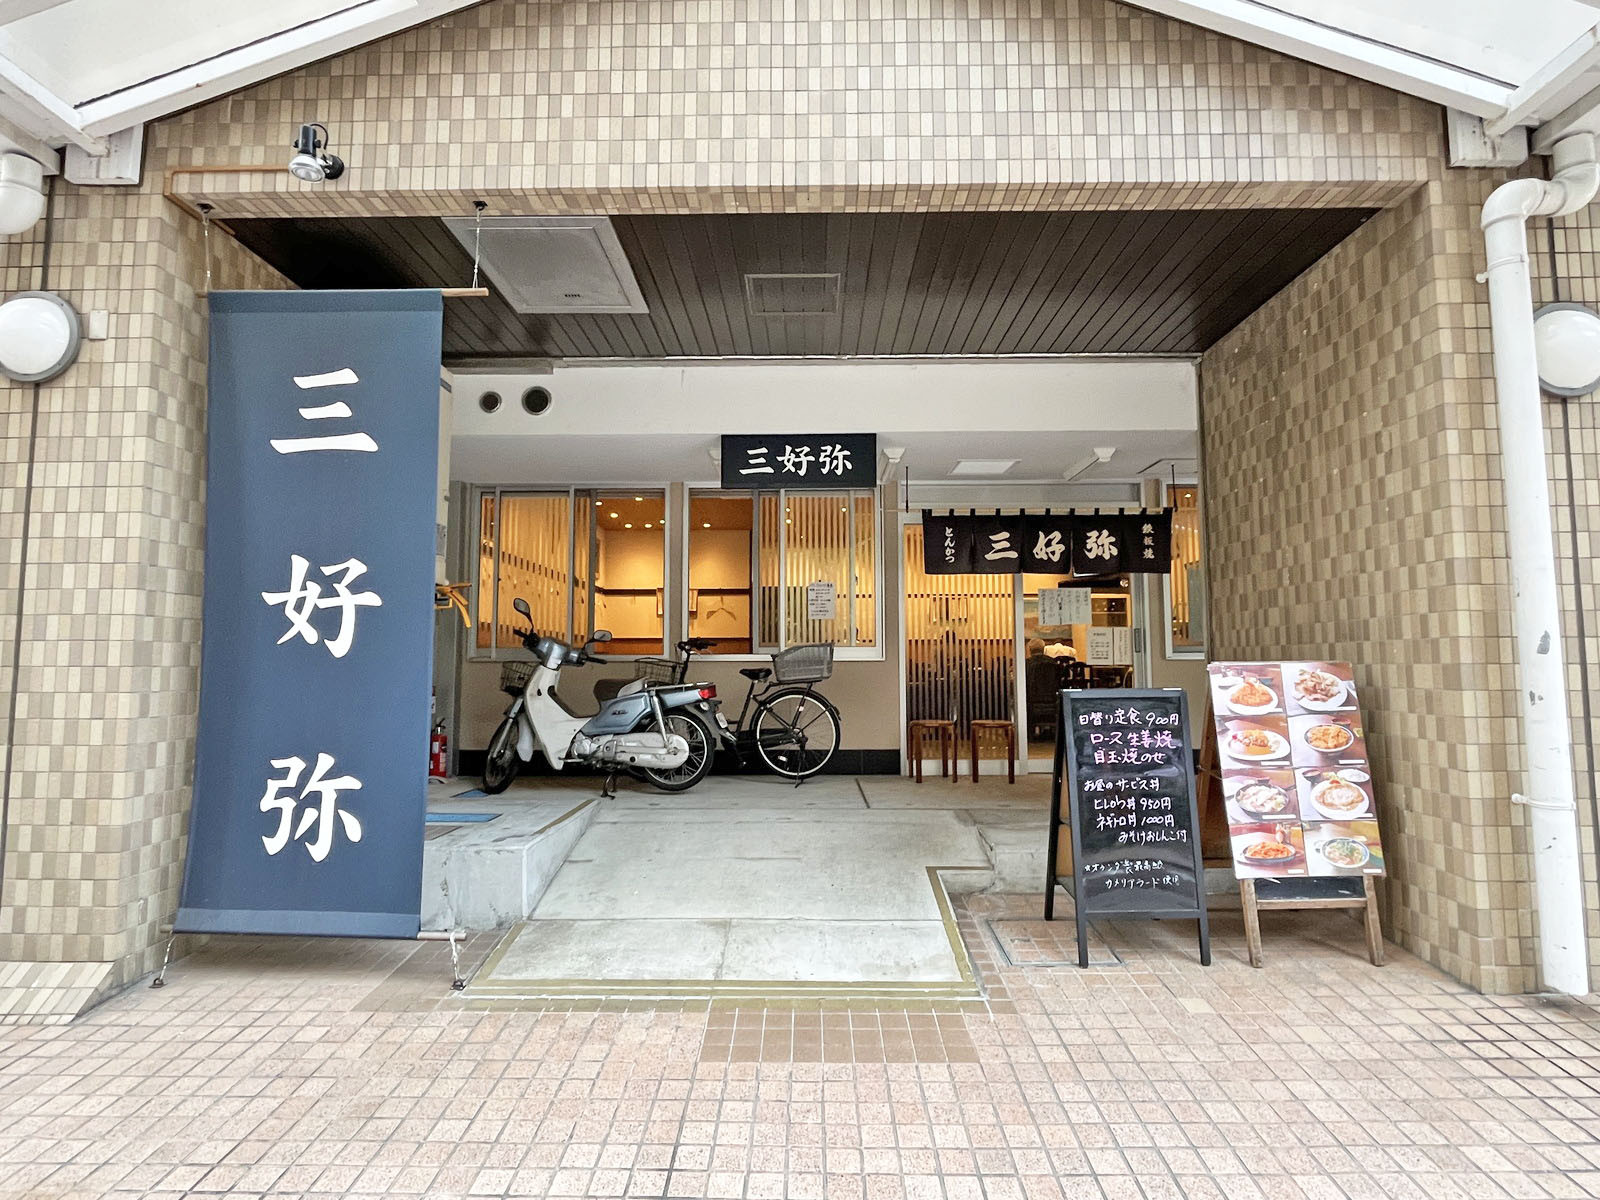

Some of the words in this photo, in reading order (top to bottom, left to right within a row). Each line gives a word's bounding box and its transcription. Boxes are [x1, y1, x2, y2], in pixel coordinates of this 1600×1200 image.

[739, 444, 852, 476] 三好弥
[944, 526, 956, 563] とんかつ
[984, 529, 1118, 562] 三好弥
[260, 368, 382, 863] 三好弥
[1079, 707, 1142, 725] 日替り定食
[1145, 712, 1179, 727] 900円
[1090, 731, 1123, 745] ロース
[1127, 729, 1176, 749] 生姜焼
[1094, 747, 1166, 765] 目玉焼のせ
[1140, 796, 1172, 811] 950円
[1140, 814, 1175, 828] 1000円
